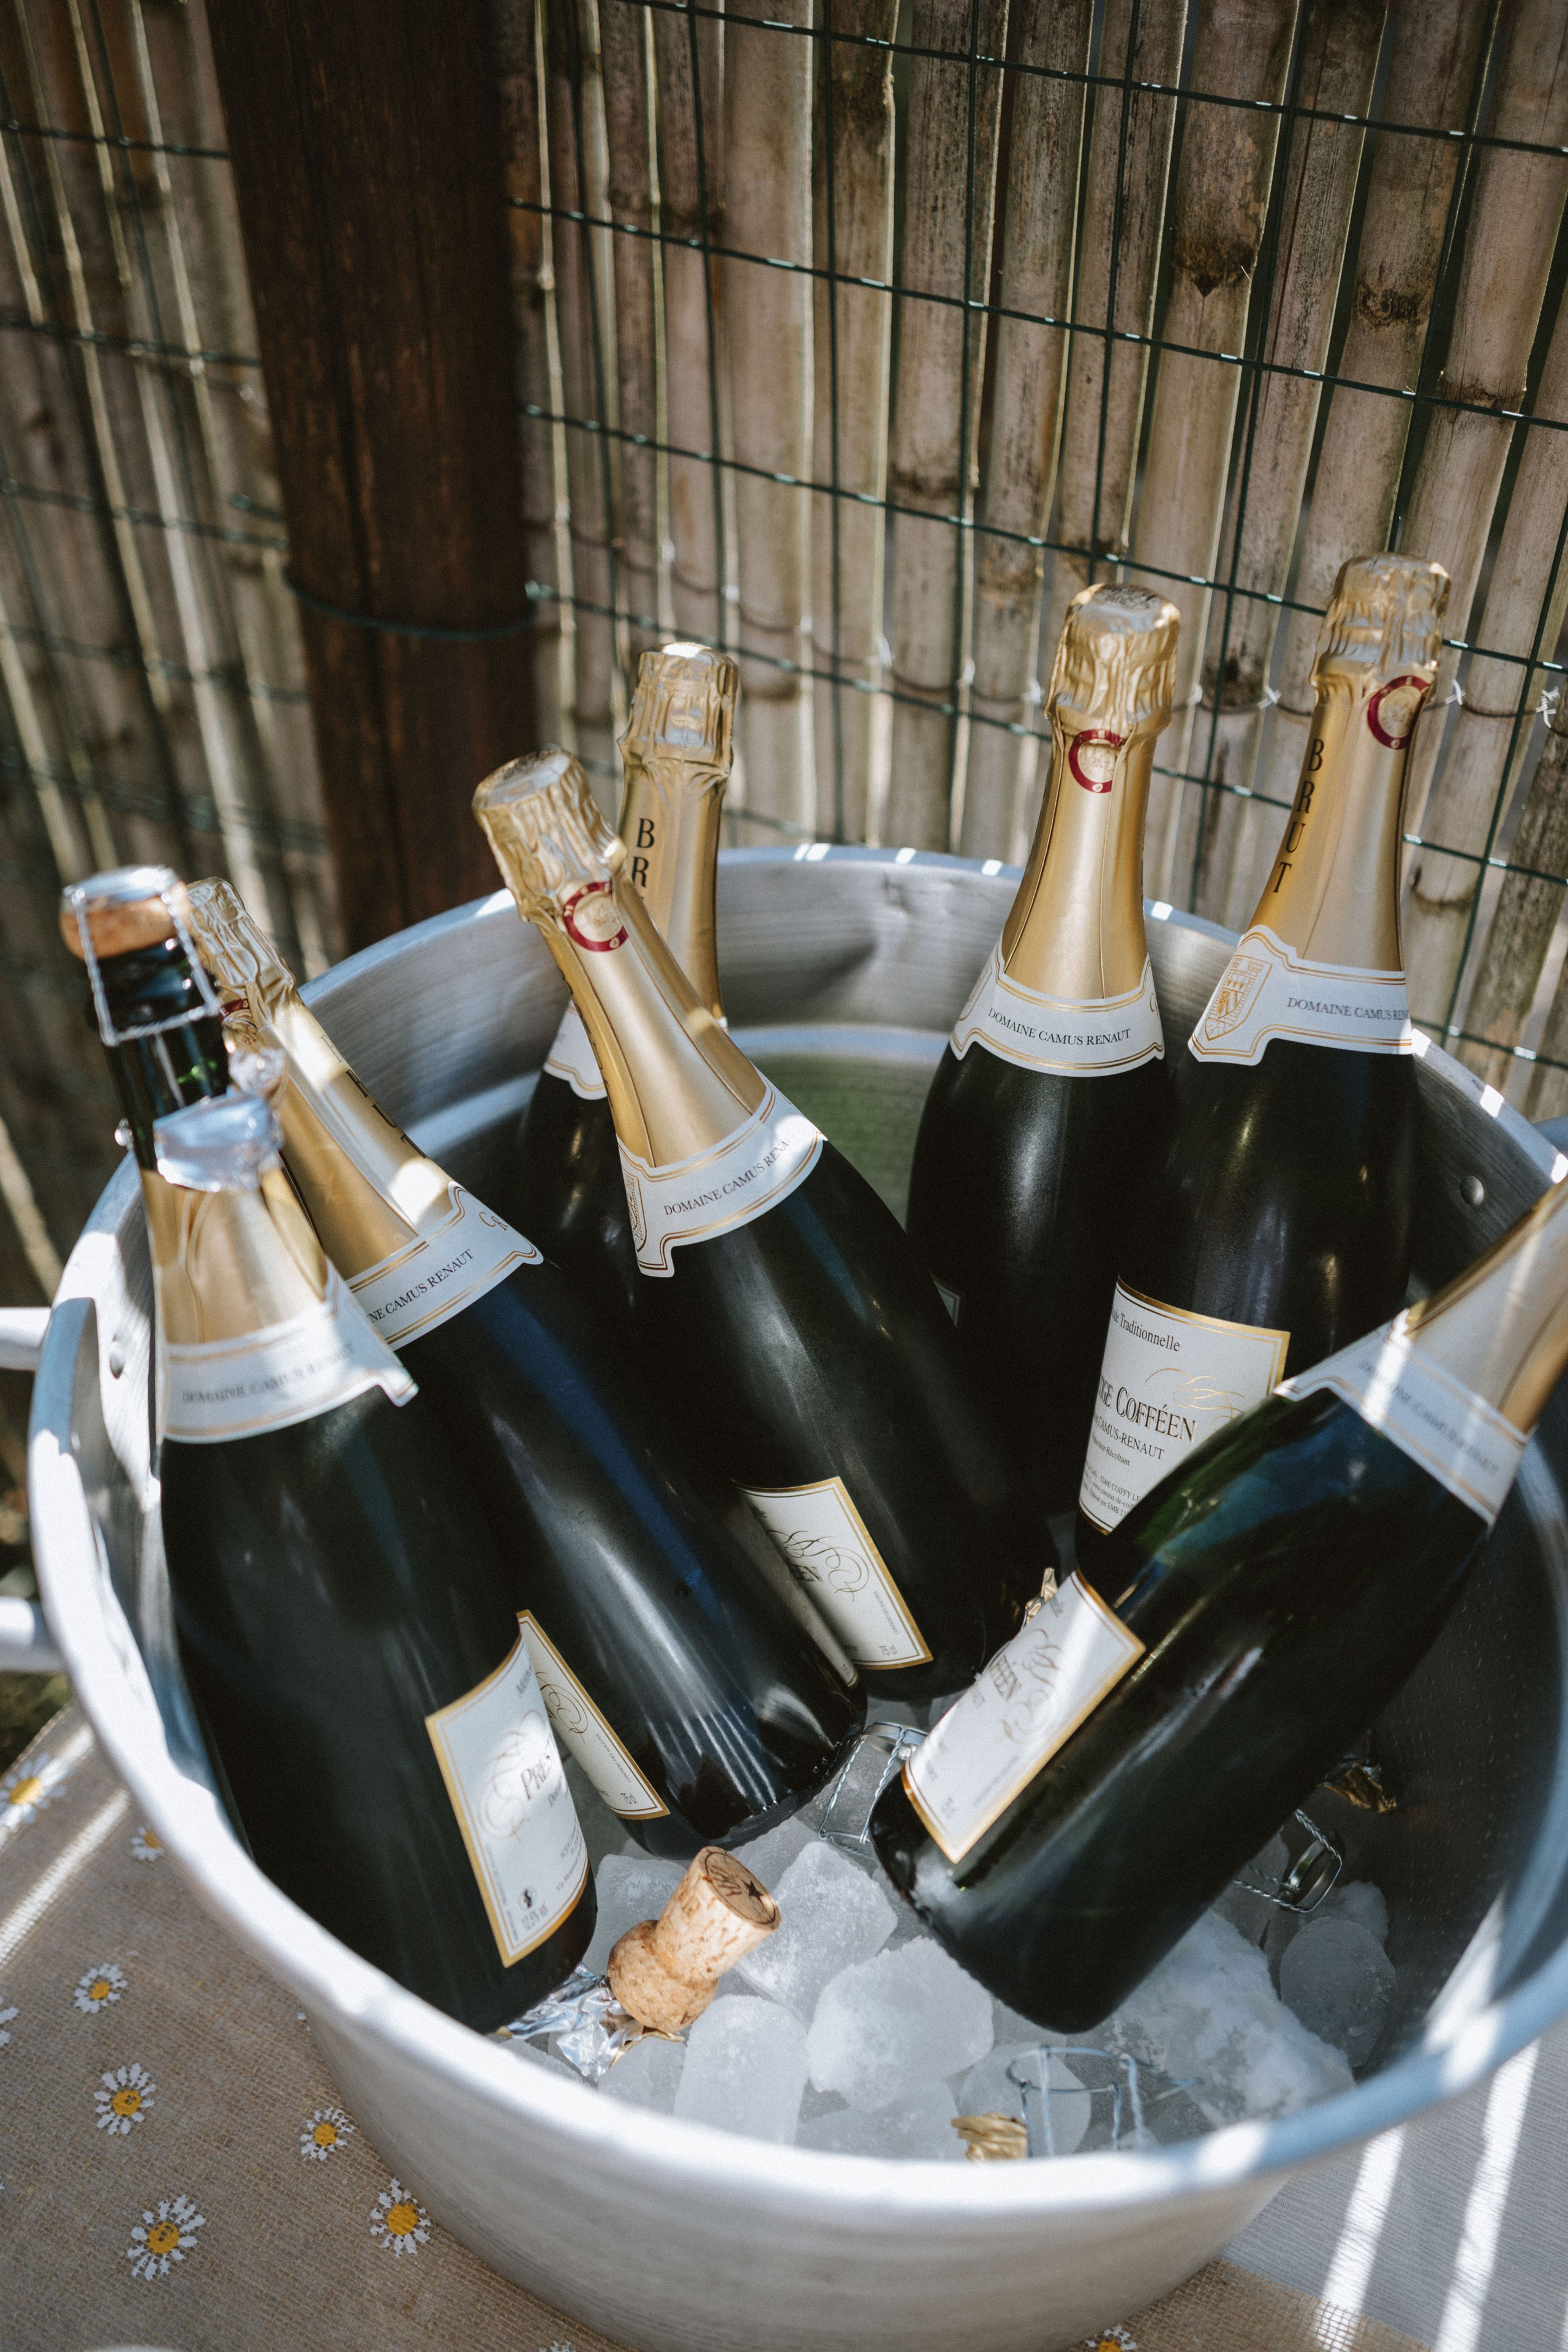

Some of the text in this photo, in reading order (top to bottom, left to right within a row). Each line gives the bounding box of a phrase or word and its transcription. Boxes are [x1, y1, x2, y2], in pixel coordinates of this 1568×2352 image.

[1273, 738, 1325, 894] BRUT
[987, 1008, 1131, 1046] DOMAINE CAMUS RENAUT
[1287, 998, 1352, 1017] DOMAINE
[1355, 1006, 1392, 1020] CAMUS
[664, 1189, 722, 1216] DOMAINE
[723, 1163, 765, 1194] CAMUS
[385, 1283, 428, 1314] CAMUS
[428, 1248, 474, 1288] RENAUT
[1120, 1313, 1181, 1352] Traditionnelle
[1098, 1415, 1165, 1460] CAMUS-RENAUT
[1116, 1386, 1198, 1444] COFFÉEN
[1111, 1483, 1132, 1499] COIFFY
